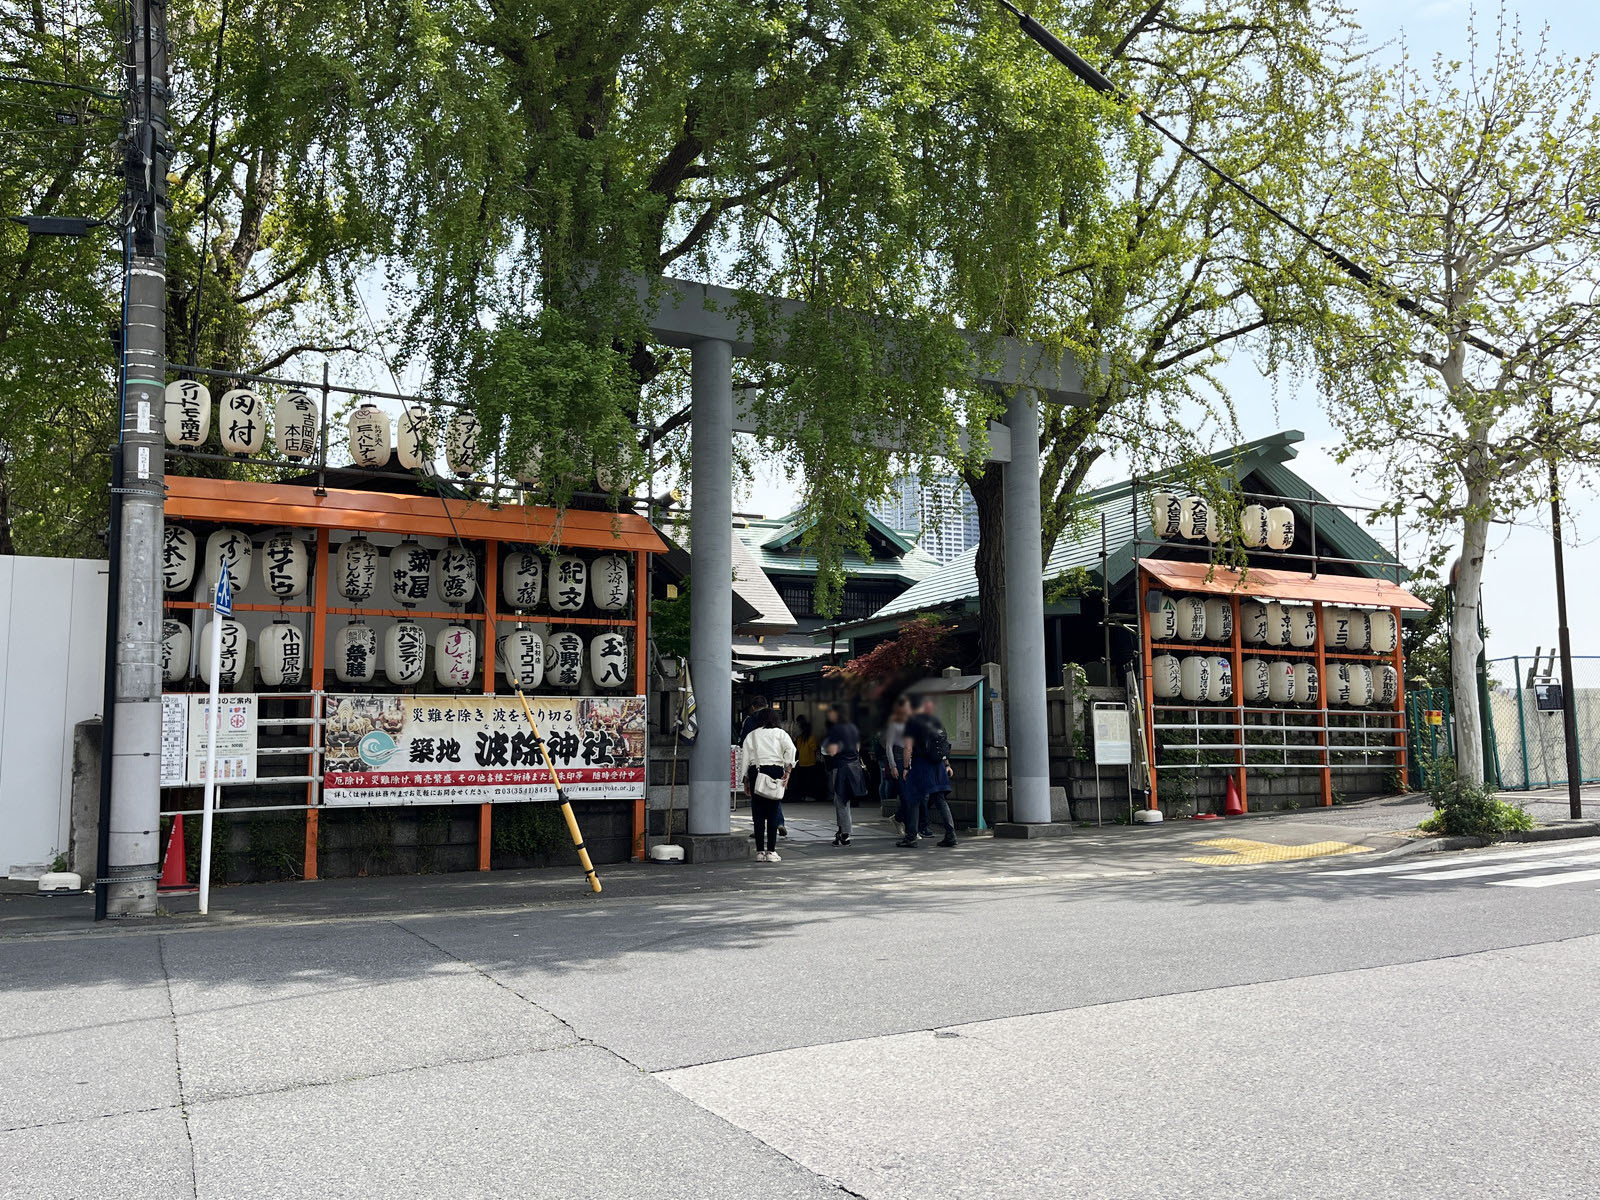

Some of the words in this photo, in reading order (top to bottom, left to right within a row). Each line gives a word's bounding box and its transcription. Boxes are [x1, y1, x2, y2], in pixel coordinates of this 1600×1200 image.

[285, 424, 301, 451] 本店
[267, 548, 294, 594] サイトウ
[345, 552, 361, 596] にっしん太助
[360, 552, 376, 599] ケーディーエム
[393, 569, 409, 594] 中村
[408, 550, 430, 598] 菊屋
[559, 561, 583, 607] 紀文
[281, 629, 300, 684] 小田原屋
[520, 635, 534, 685] ジョウコウ
[560, 635, 579, 683] 吉野家
[412, 708, 484, 722] 災難を除き
[409, 737, 461, 764] 築地
[475, 730, 615, 767] 波除神社
[592, 770, 636, 780] 随時受付中
